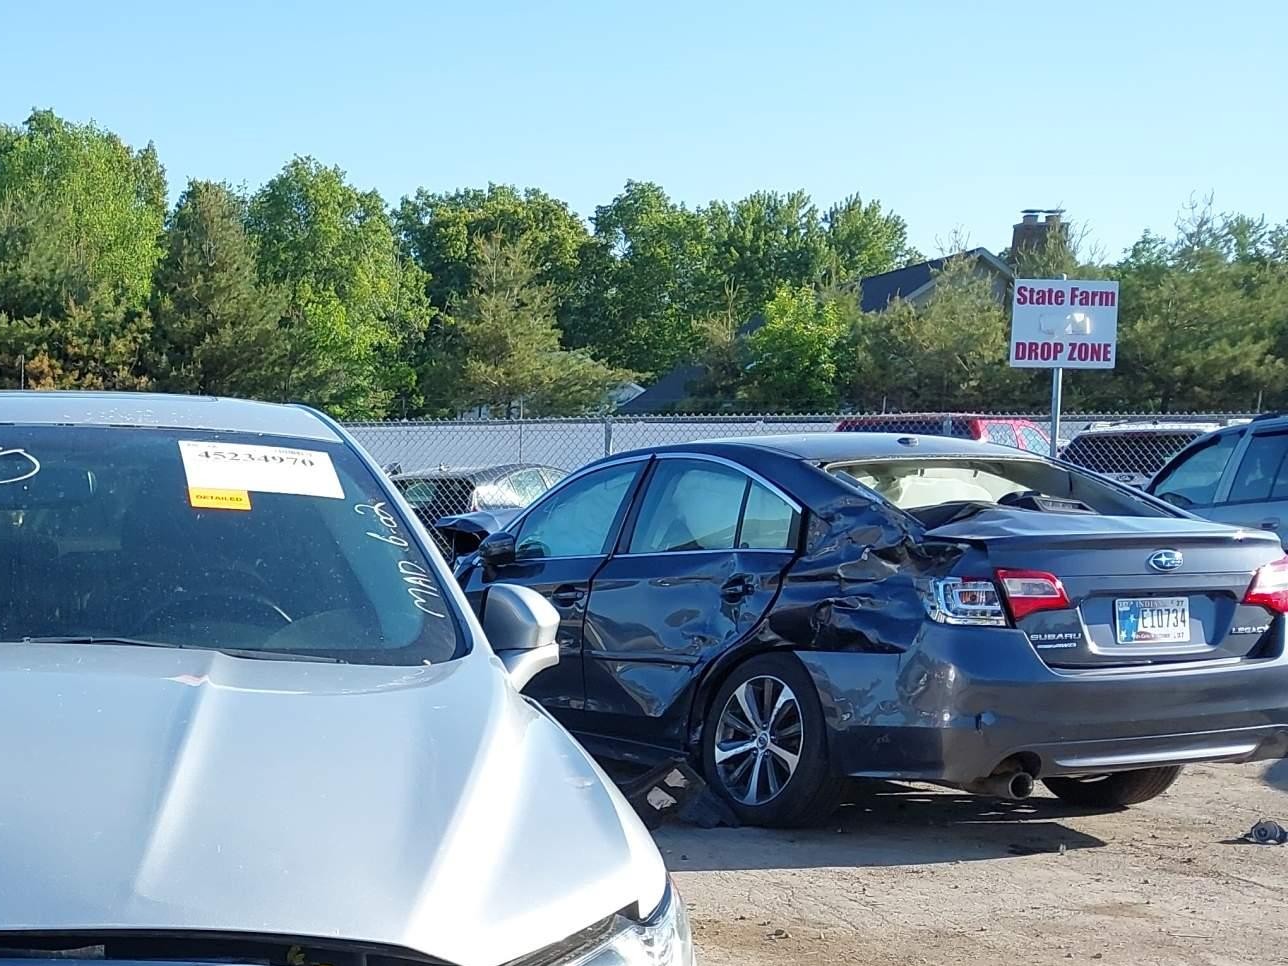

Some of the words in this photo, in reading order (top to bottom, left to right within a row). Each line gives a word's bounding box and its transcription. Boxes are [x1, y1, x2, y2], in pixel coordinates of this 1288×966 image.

[1017, 286, 1065, 306] State
[1070, 287, 1115, 306] Farm
[1015, 342, 1064, 360] DROP
[1068, 343, 1112, 362] ZONE
[197, 450, 316, 468] 45234970
[195, 494, 244, 503] DETAILED
[1231, 624, 1270, 634] LEGACY
[1030, 632, 1082, 641] SUBARU
